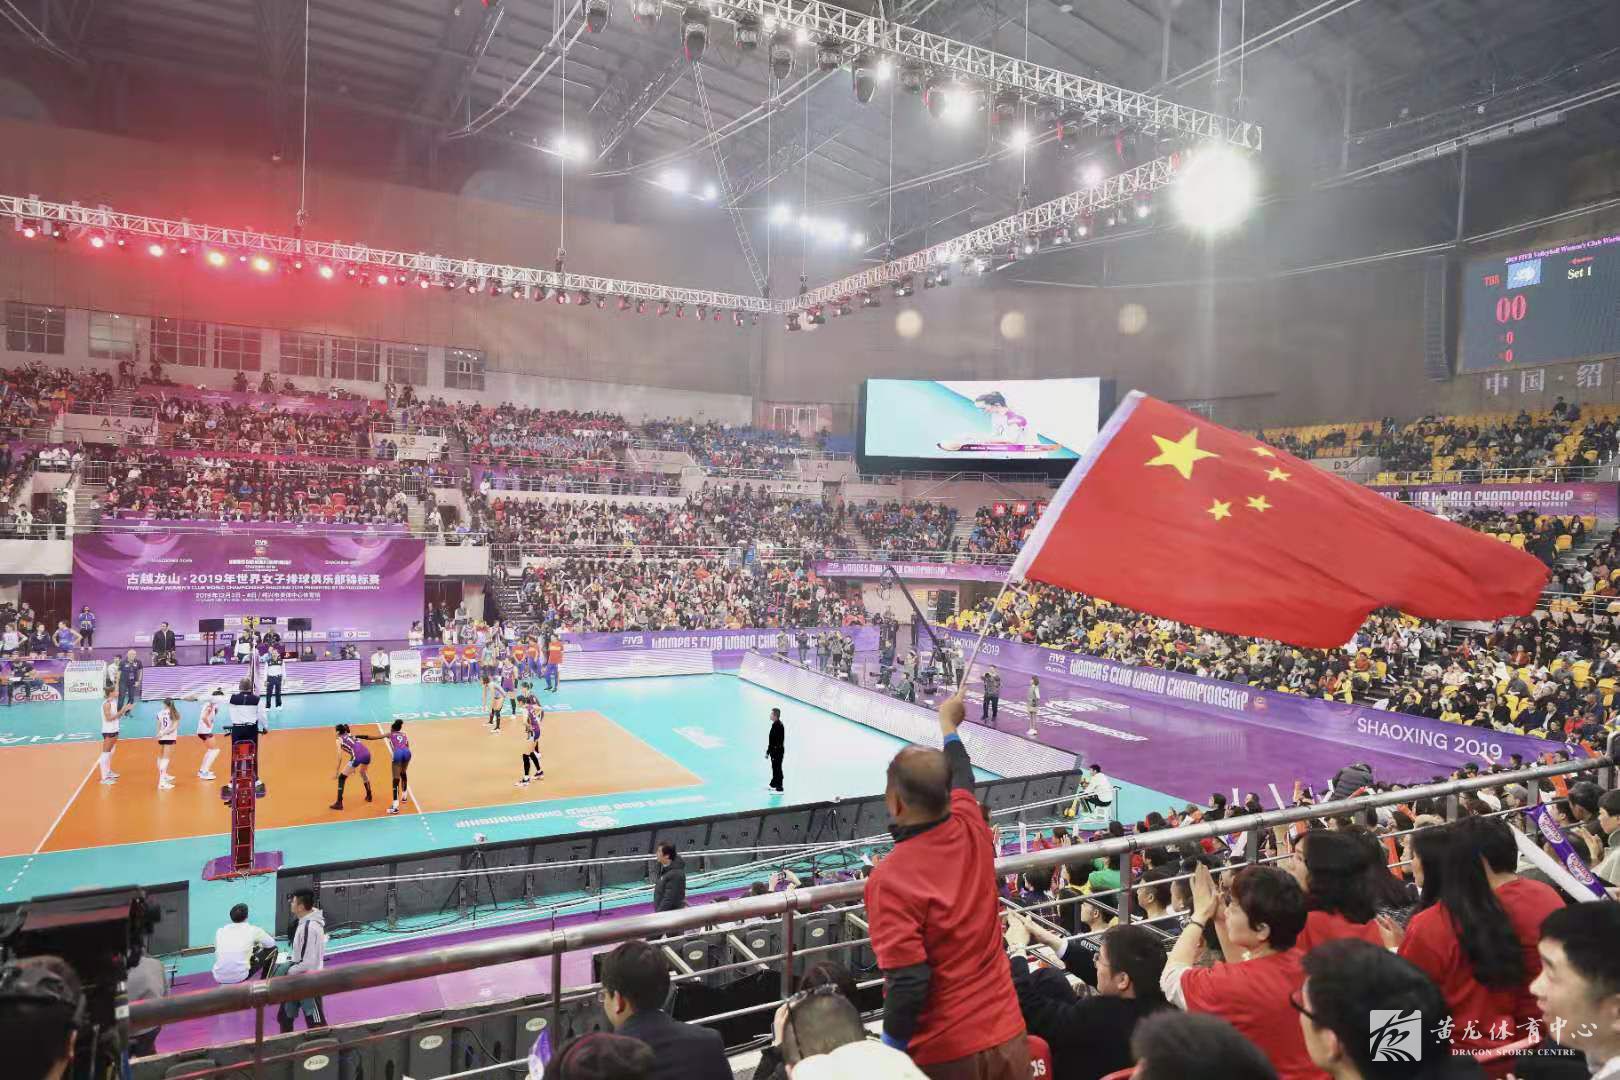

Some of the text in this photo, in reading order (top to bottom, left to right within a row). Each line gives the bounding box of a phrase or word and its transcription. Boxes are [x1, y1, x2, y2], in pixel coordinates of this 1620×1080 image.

[1568, 268, 1584, 280] Set
[1496, 294, 1527, 324] 00
[982, 642, 1000, 656] 2019
[396, 735, 403, 744] 9
[1357, 717, 1504, 760] SHAOXING 2019
